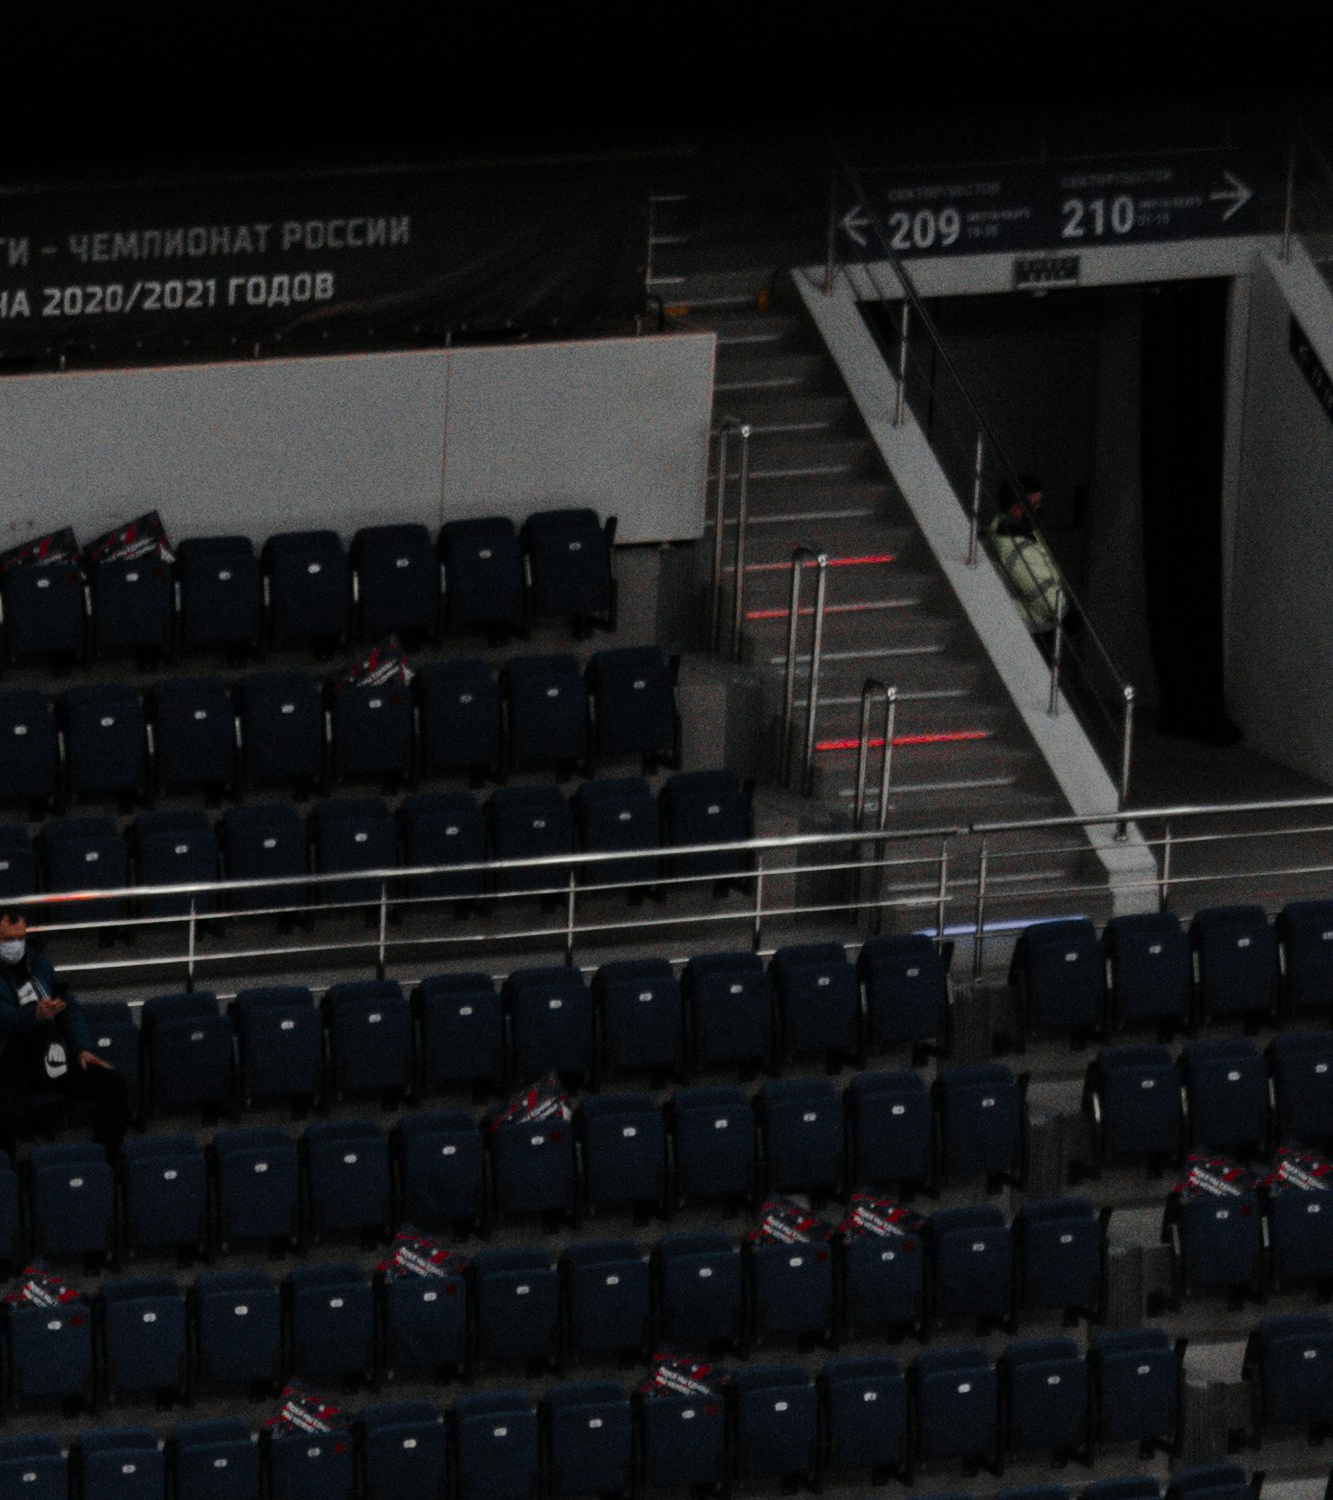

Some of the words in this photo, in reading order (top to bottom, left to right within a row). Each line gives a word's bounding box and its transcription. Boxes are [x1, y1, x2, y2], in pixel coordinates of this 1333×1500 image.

[888, 208, 960, 249] 209
[1061, 195, 1134, 238] 210
[68, 223, 271, 262] ЧЕМПИОНАТ
[282, 216, 411, 250] РОССИИ
[41, 278, 216, 318] 2020/2021
[228, 272, 335, 306] ГОДОВ
